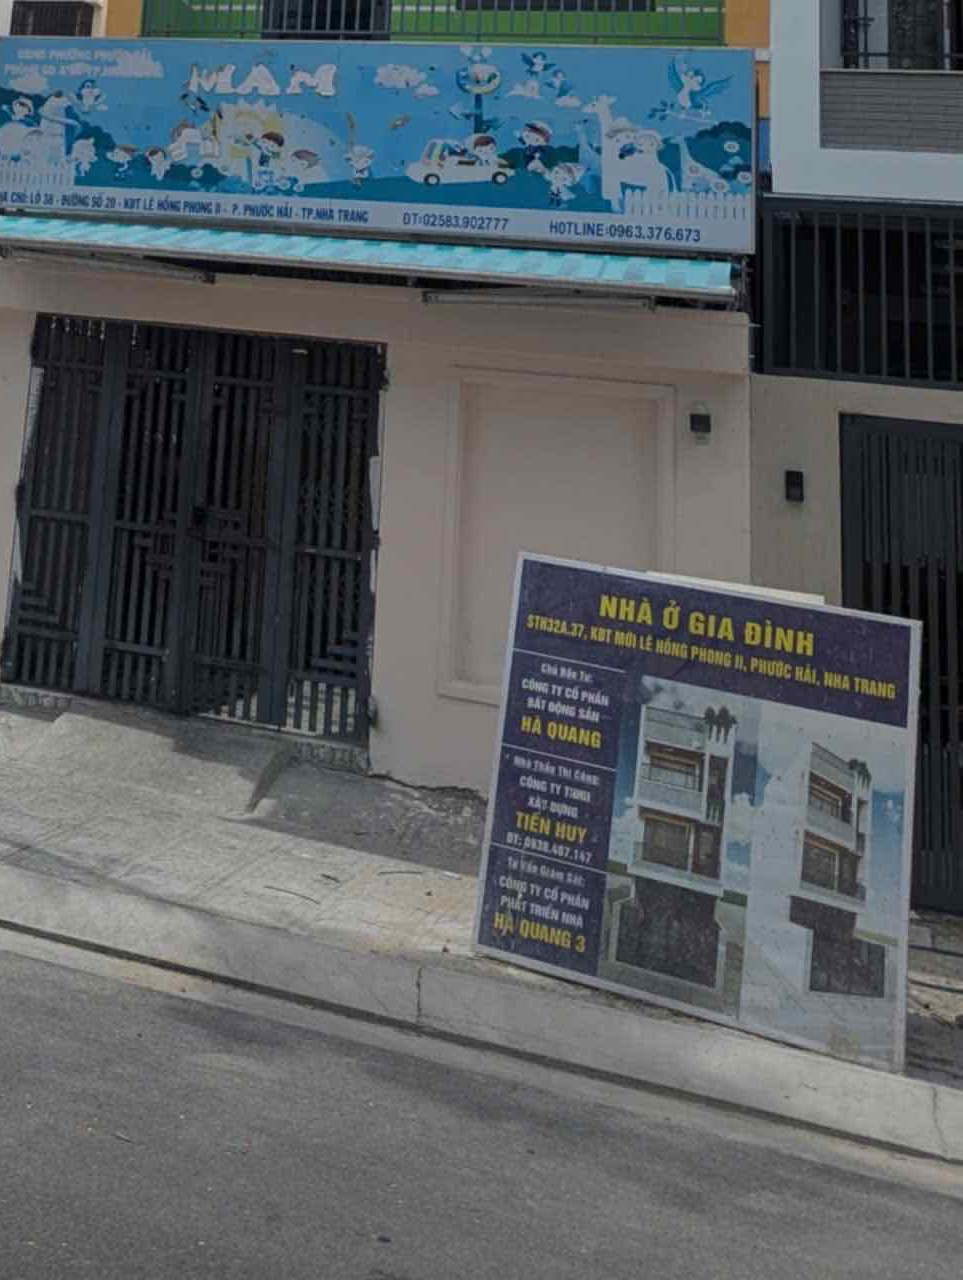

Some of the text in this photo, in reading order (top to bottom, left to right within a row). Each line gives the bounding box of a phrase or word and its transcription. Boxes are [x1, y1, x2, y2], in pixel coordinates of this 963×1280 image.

[338, 209, 369, 224] TRANG
[599, 593, 815, 657] NHÀ Ở GIA ĐÌNH
[690, 646, 732, 668] PHONG
[823, 671, 851, 691] NHA
[854, 677, 897, 700] TRANG
[521, 677, 550, 694] CÔNG
[551, 683, 564, 697] TY
[520, 714, 602, 750] HÀ QUANG
[519, 774, 548, 793] CÔNG
[549, 782, 562, 796] TY
[555, 819, 589, 846] HUY
[529, 882, 543, 898] TY
[519, 918, 573, 949] QUANG
[574, 934, 587, 953] 3
